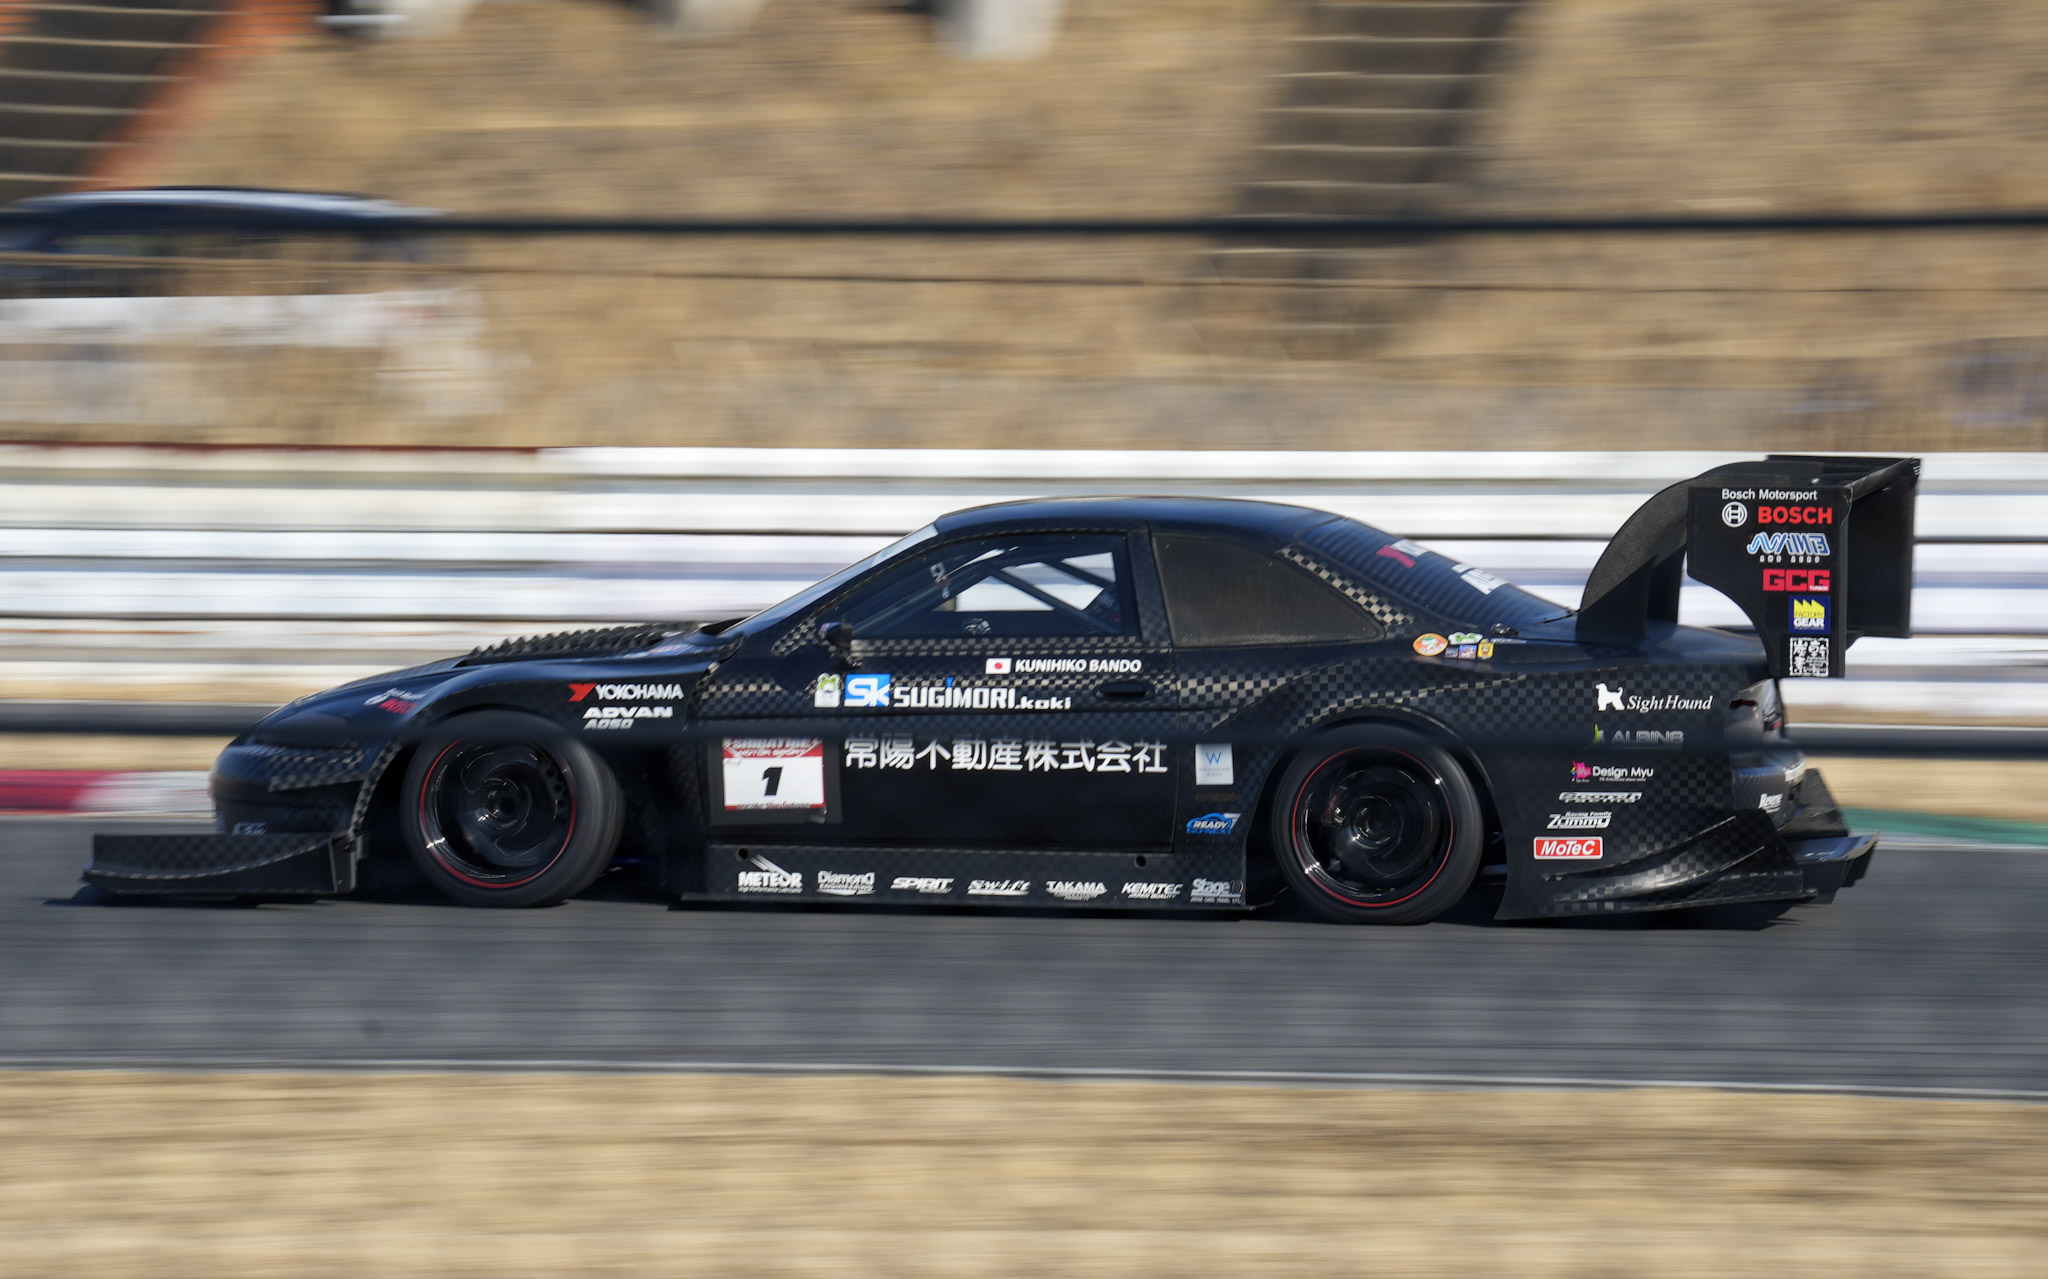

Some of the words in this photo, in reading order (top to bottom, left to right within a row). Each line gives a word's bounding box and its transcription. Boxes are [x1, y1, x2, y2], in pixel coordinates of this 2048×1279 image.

[1722, 488, 1755, 500] Bosch
[1759, 488, 1818, 502] Motorsport
[1758, 506, 1833, 525] BOSCH
[1763, 569, 1831, 592] GCG
[1793, 617, 1825, 628] GEAR
[1015, 659, 1087, 673] KUNIHIKO
[1089, 659, 1142, 673] BANDO
[595, 683, 685, 700] YOKOHAMA
[582, 706, 673, 719] ADVAN
[843, 732, 1169, 773] 常陽不動産株式会社
[1205, 751, 1222, 765] W
[1592, 766, 1628, 779] Design
[1631, 766, 1654, 779] Myu
[761, 766, 783, 797] 1
[1193, 820, 1228, 829] READY
[1540, 840, 1596, 856] MoTeC
[738, 871, 803, 888] METEOR
[890, 877, 954, 890] SPIRIT
[1046, 881, 1108, 893] TAKAMA
[1121, 882, 1183, 895] KEMITEC
